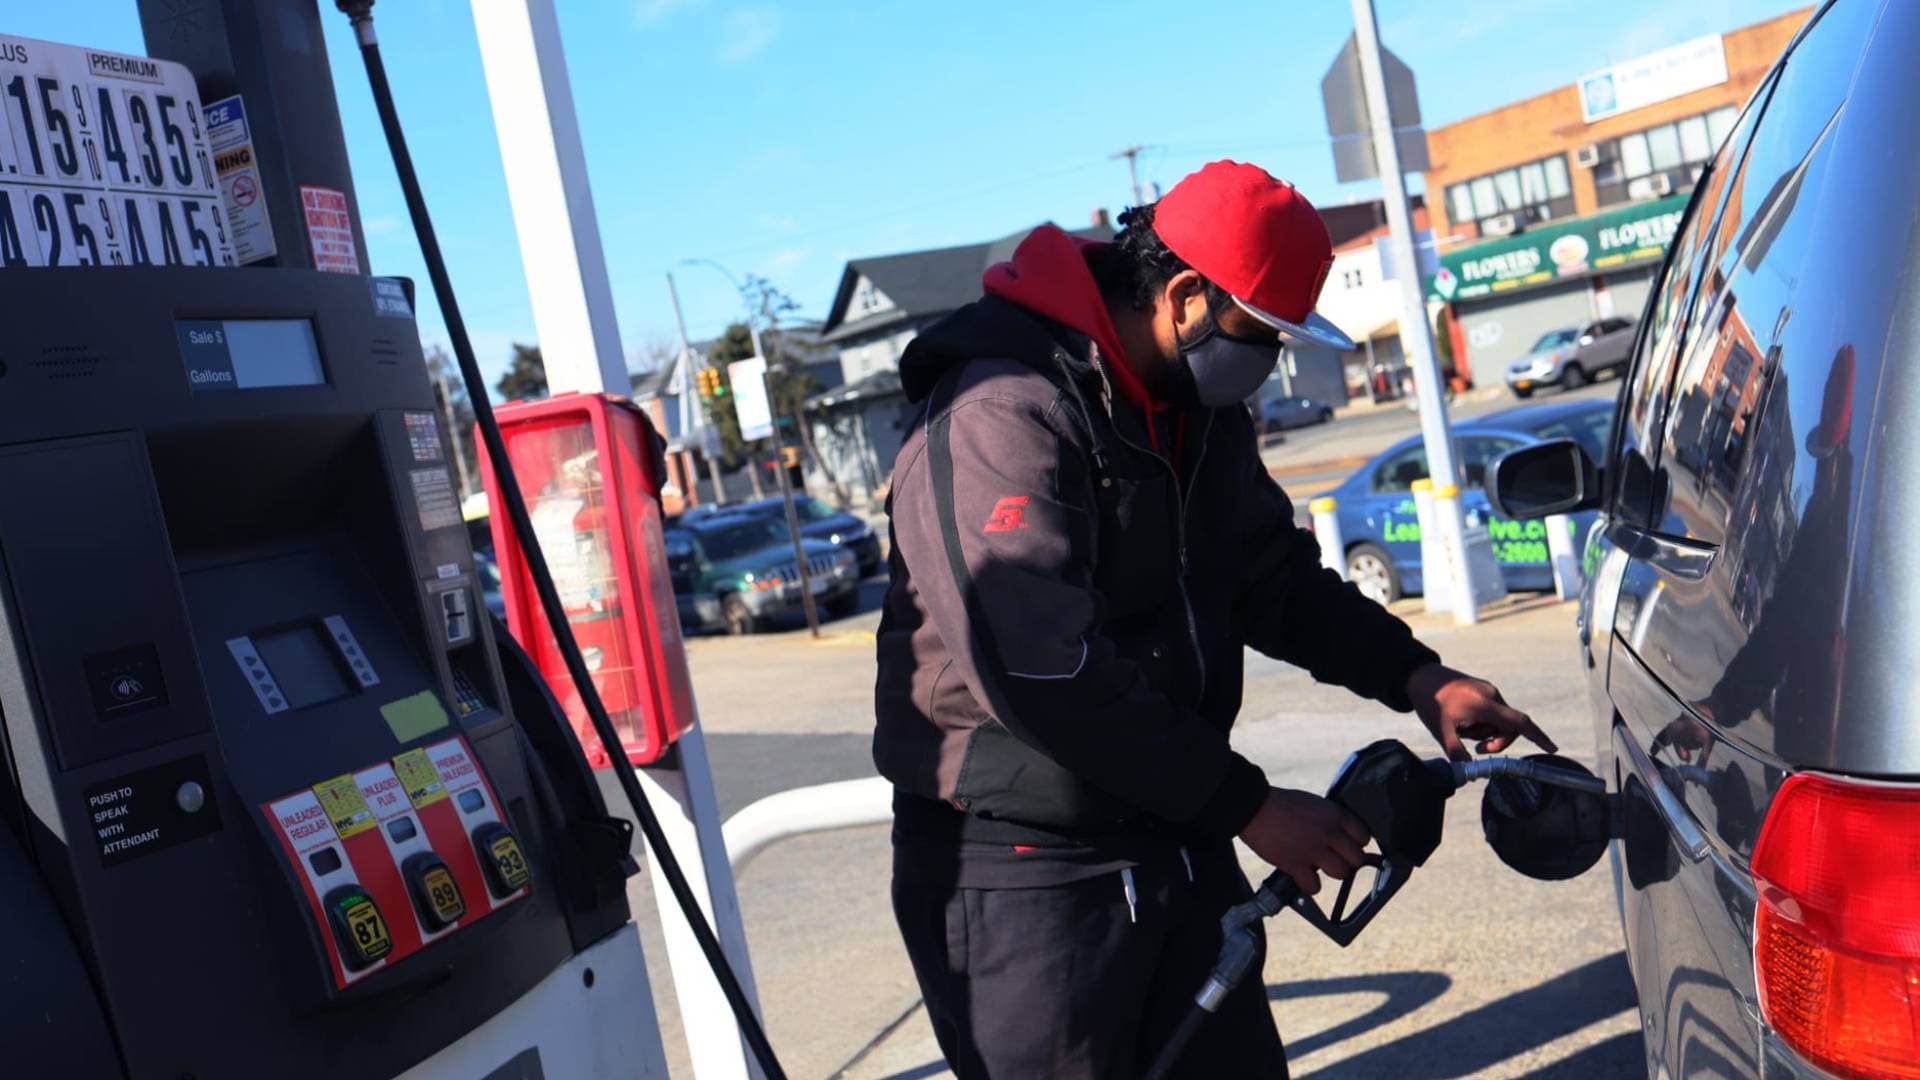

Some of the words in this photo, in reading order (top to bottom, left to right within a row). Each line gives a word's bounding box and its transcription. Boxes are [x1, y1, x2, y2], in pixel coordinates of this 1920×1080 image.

[0, 43, 28, 64] US
[91, 53, 158, 79] PREMIUM
[97, 87, 193, 187] 4.35
[1462, 247, 1541, 281] FLOWERS
[189, 330, 214, 344] Sale
[215, 331, 224, 344] $
[190, 369, 232, 383] Gallons
[89, 790, 118, 807] PUSH
[118, 786, 133, 799] TO
[362, 776, 401, 799] UNLEADED
[376, 791, 397, 807] PLUS
[94, 804, 129, 823] SPEAK
[281, 803, 324, 829] UNLEADED
[335, 816, 354, 830] NYC
[98, 823, 125, 839] WITH
[290, 818, 328, 840] REGULAR
[103, 828, 160, 855] ATTENDANT
[499, 849, 524, 876] 93
[431, 882, 456, 908] 89
[355, 914, 382, 946] 87
